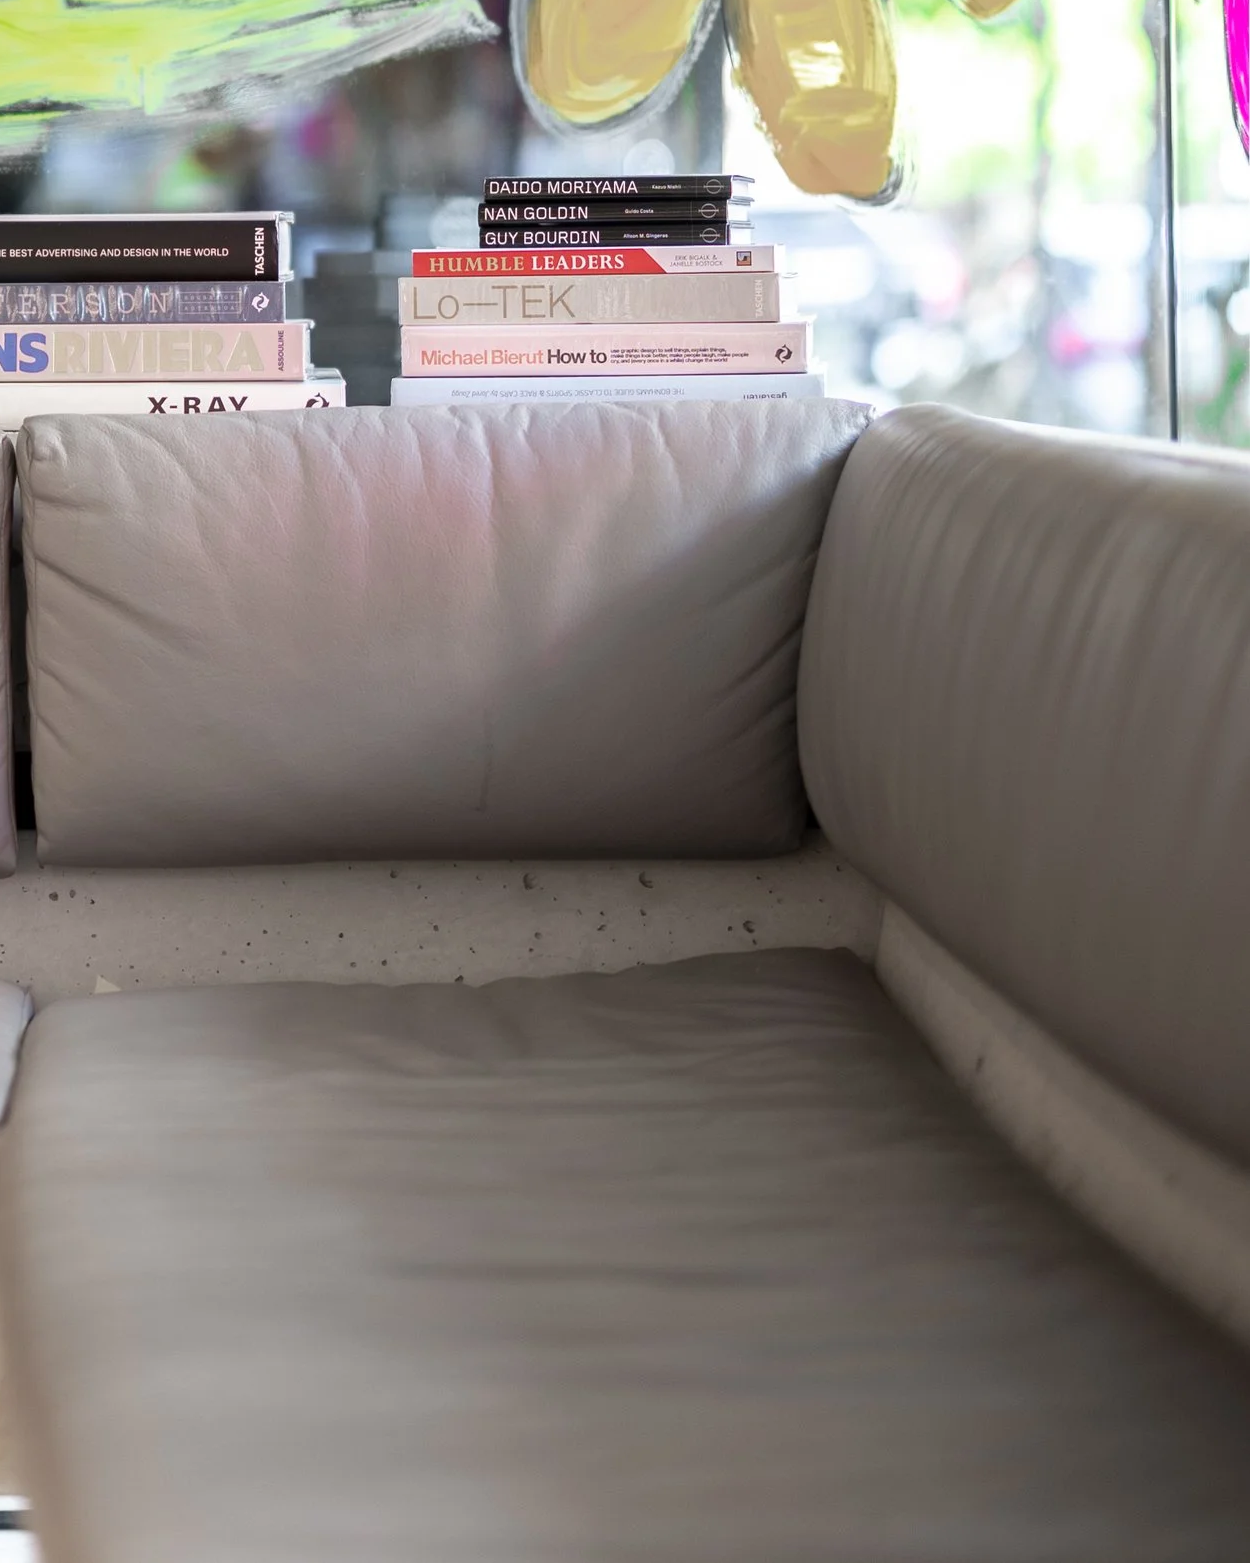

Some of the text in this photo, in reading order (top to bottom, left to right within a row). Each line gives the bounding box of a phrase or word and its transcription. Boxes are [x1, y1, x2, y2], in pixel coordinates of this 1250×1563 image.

[489, 180, 639, 195] DAIDO MORIYAMA
[484, 206, 589, 221] NAN GOLDIN
[485, 231, 600, 246] GUY BOURDIN
[9, 248, 33, 258] BEST
[35, 248, 98, 258] ADVERTISING
[100, 248, 121, 257] AND
[123, 248, 159, 257] DESIGN
[161, 248, 171, 257] IN
[173, 248, 192, 257] THE
[193, 247, 229, 257] WORLD
[254, 227, 265, 276] TASCHEN
[429, 254, 625, 272] HUMBLE LEADERS
[755, 279, 764, 319] TASCHEN
[52, 330, 265, 374] RIVIERA
[277, 330, 285, 372] ASSOULINE
[420, 349, 607, 366] Michael Bierut How to
[499, 390, 518, 398] CARS
[546, 389, 573, 397] SPORTS
[575, 389, 603, 397] CLASSIC
[614, 388, 635, 396] GUIDE
[147, 396, 248, 415] X-RAY
